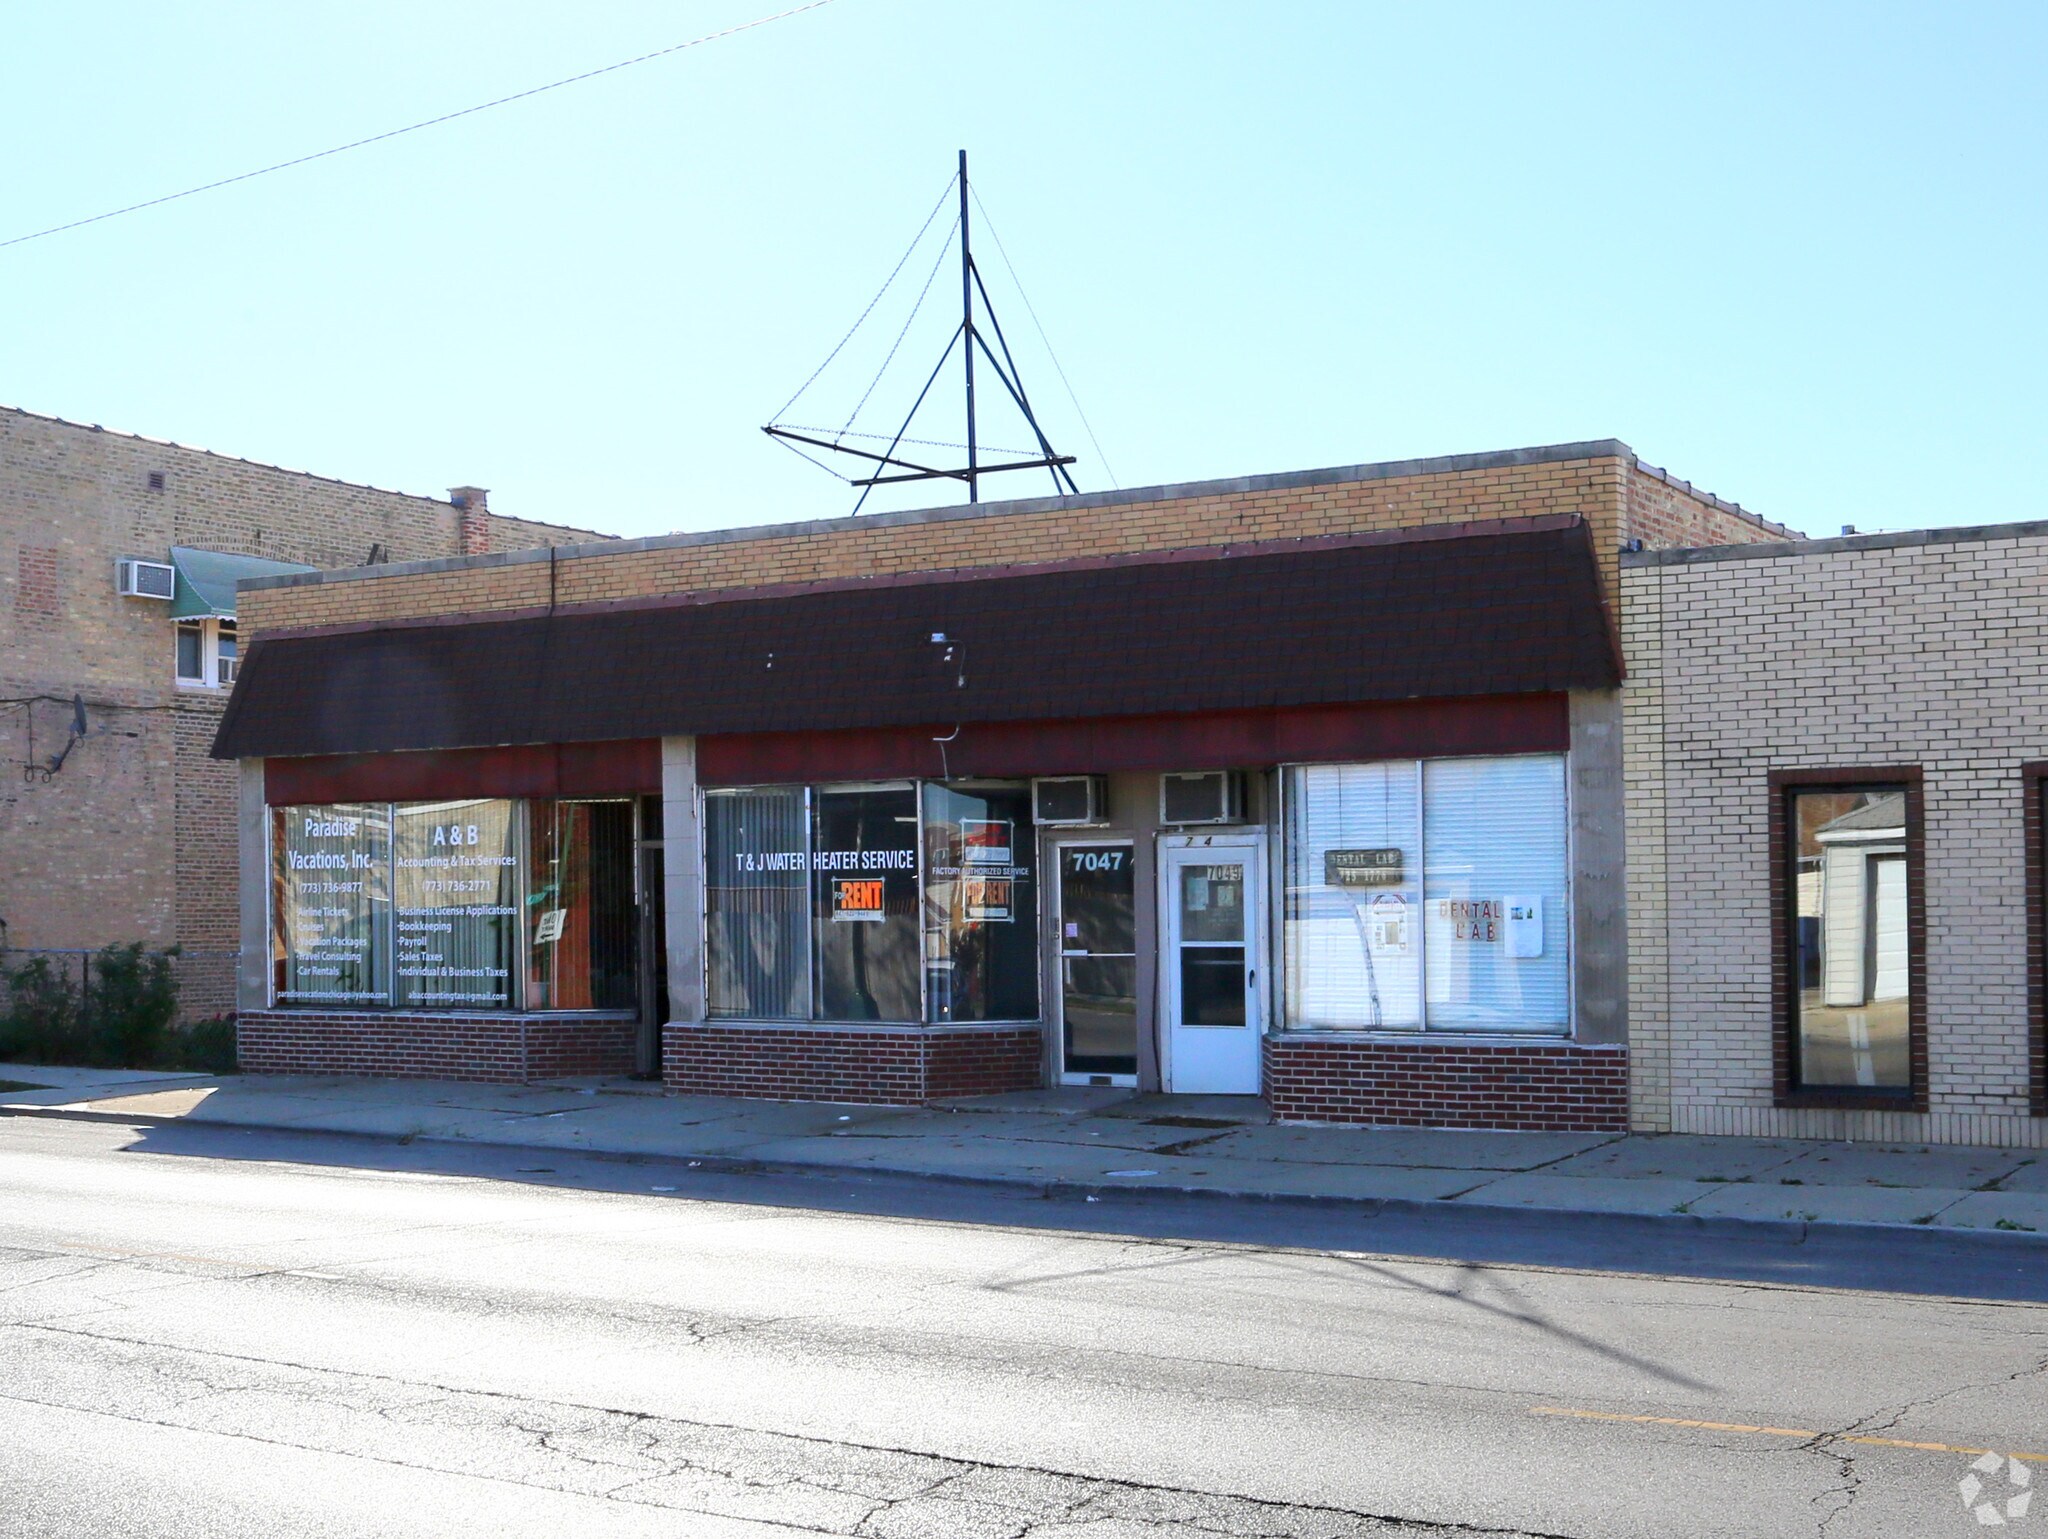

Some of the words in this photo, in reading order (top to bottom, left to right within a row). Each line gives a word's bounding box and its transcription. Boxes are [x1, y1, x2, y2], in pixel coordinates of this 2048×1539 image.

[305, 817, 356, 837] Paradise
[433, 826, 446, 845] A
[450, 825, 463, 845] &
[467, 825, 479, 845] B
[1186, 836, 1194, 847] 7
[1204, 836, 1213, 847] 4
[288, 850, 349, 871] Vacations,
[351, 849, 373, 869] Inc.
[398, 856, 449, 869] Accounting
[450, 855, 458, 867] &
[459, 855, 476, 866] Tax
[477, 854, 517, 866] Services
[735, 854, 744, 871] T
[746, 853, 754, 871] &
[757, 854, 764, 871] J
[766, 853, 805, 870] WATER
[813, 852, 859, 870] HEATER
[861, 850, 914, 869] SERVICE
[1072, 852, 1123, 871] 7047
[932, 867, 960, 875] FACTORY
[961, 867, 1002, 876] AUTHORIZED
[1002, 867, 1029, 875] SERVICE
[1208, 866, 1239, 880] 7049
[300, 882, 321, 895] (773)
[322, 882, 363, 893] 736-9877
[422, 881, 446, 893] (773)
[448, 880, 491, 892] 736-2771
[841, 881, 883, 910] RENT
[299, 907, 323, 917] Airline
[323, 907, 350, 917] Tickets
[399, 907, 434, 916] Business
[435, 906, 465, 915] License
[466, 905, 518, 917] Applications
[1440, 903, 1501, 918] DENTAL
[399, 921, 452, 933] Bookkeeping
[1456, 923, 1496, 940] LAB
[300, 938, 332, 947] Vacation
[332, 936, 367, 949] Packages
[399, 936, 427, 948] Payroll
[300, 952, 321, 961] Travel
[321, 952, 362, 964] Consulting
[399, 952, 421, 962] Sales
[422, 952, 444, 962] Taxes
[298, 966, 312, 976] Car
[312, 966, 340, 976] Rentals
[399, 966, 440, 977] Individual
[440, 967, 448, 977] &
[448, 966, 484, 977] Business
[485, 966, 509, 977] Taxes
